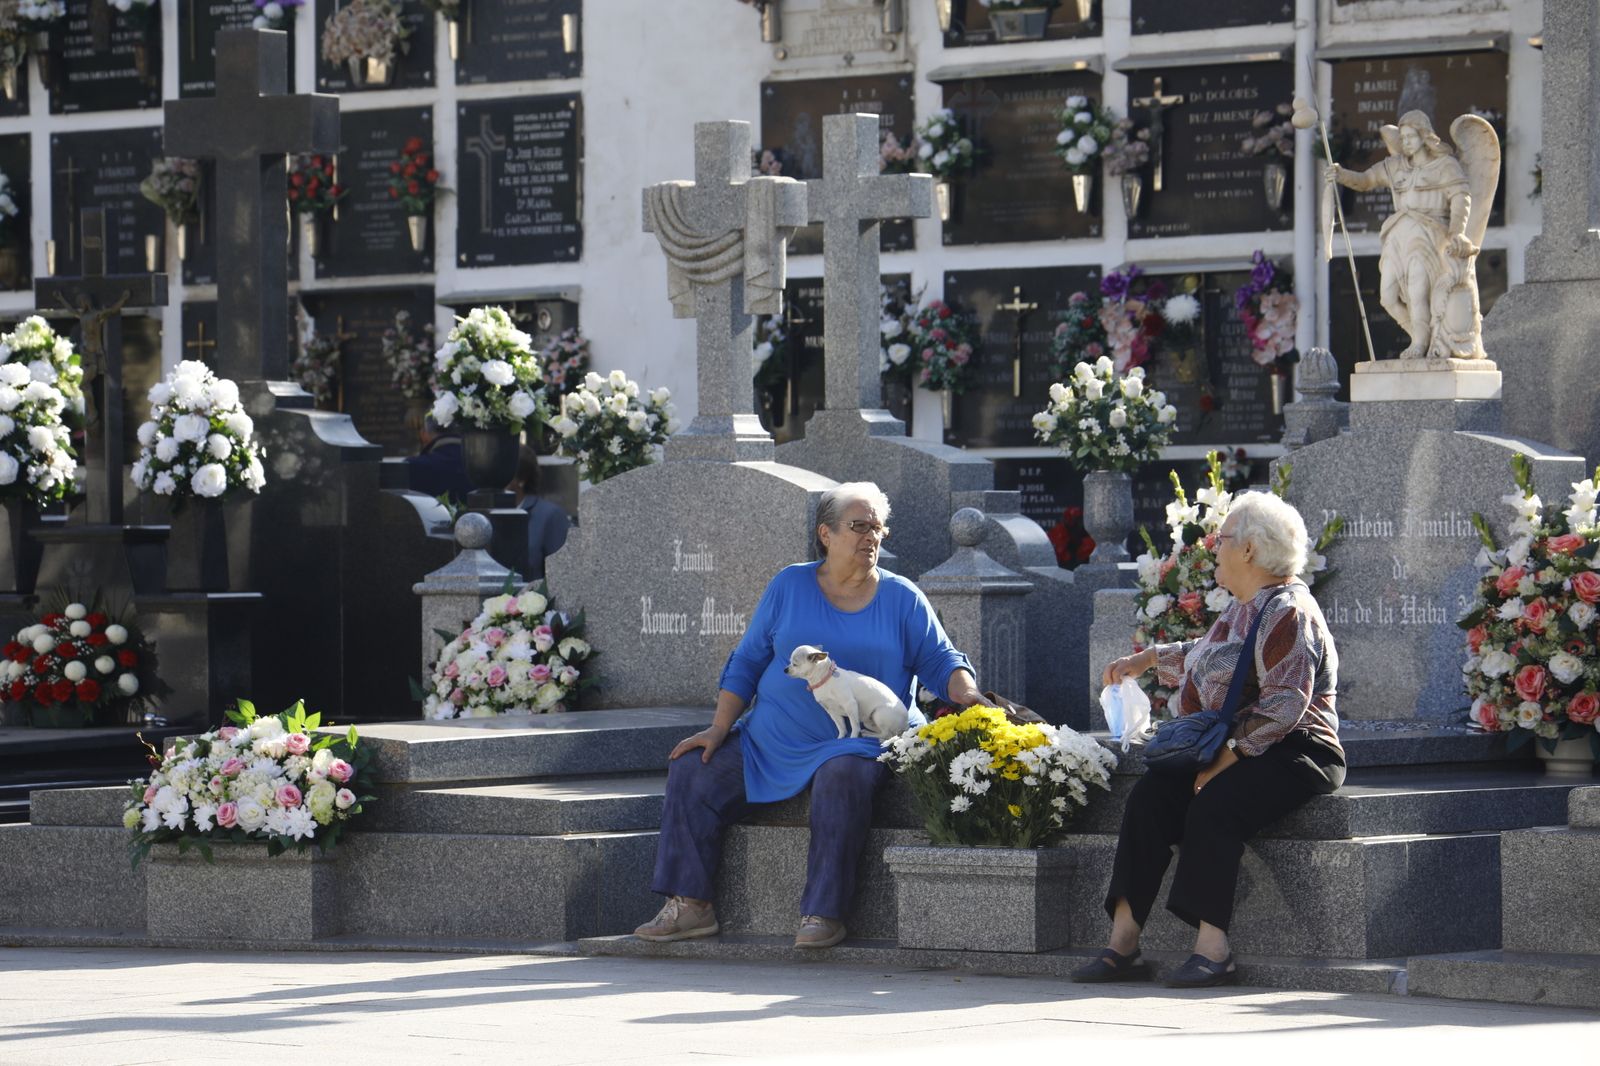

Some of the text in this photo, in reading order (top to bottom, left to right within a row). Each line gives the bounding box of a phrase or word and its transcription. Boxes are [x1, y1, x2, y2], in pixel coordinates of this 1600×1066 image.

[1206, 88, 1259, 101] DOLORES
[1362, 80, 1397, 92] MANUEL
[671, 538, 714, 574] Familia
[1392, 555, 1409, 580] de
[640, 596, 687, 644] Romero
[700, 596, 747, 646] Montes
[1355, 599, 1372, 624] de
[1378, 598, 1394, 624] la
